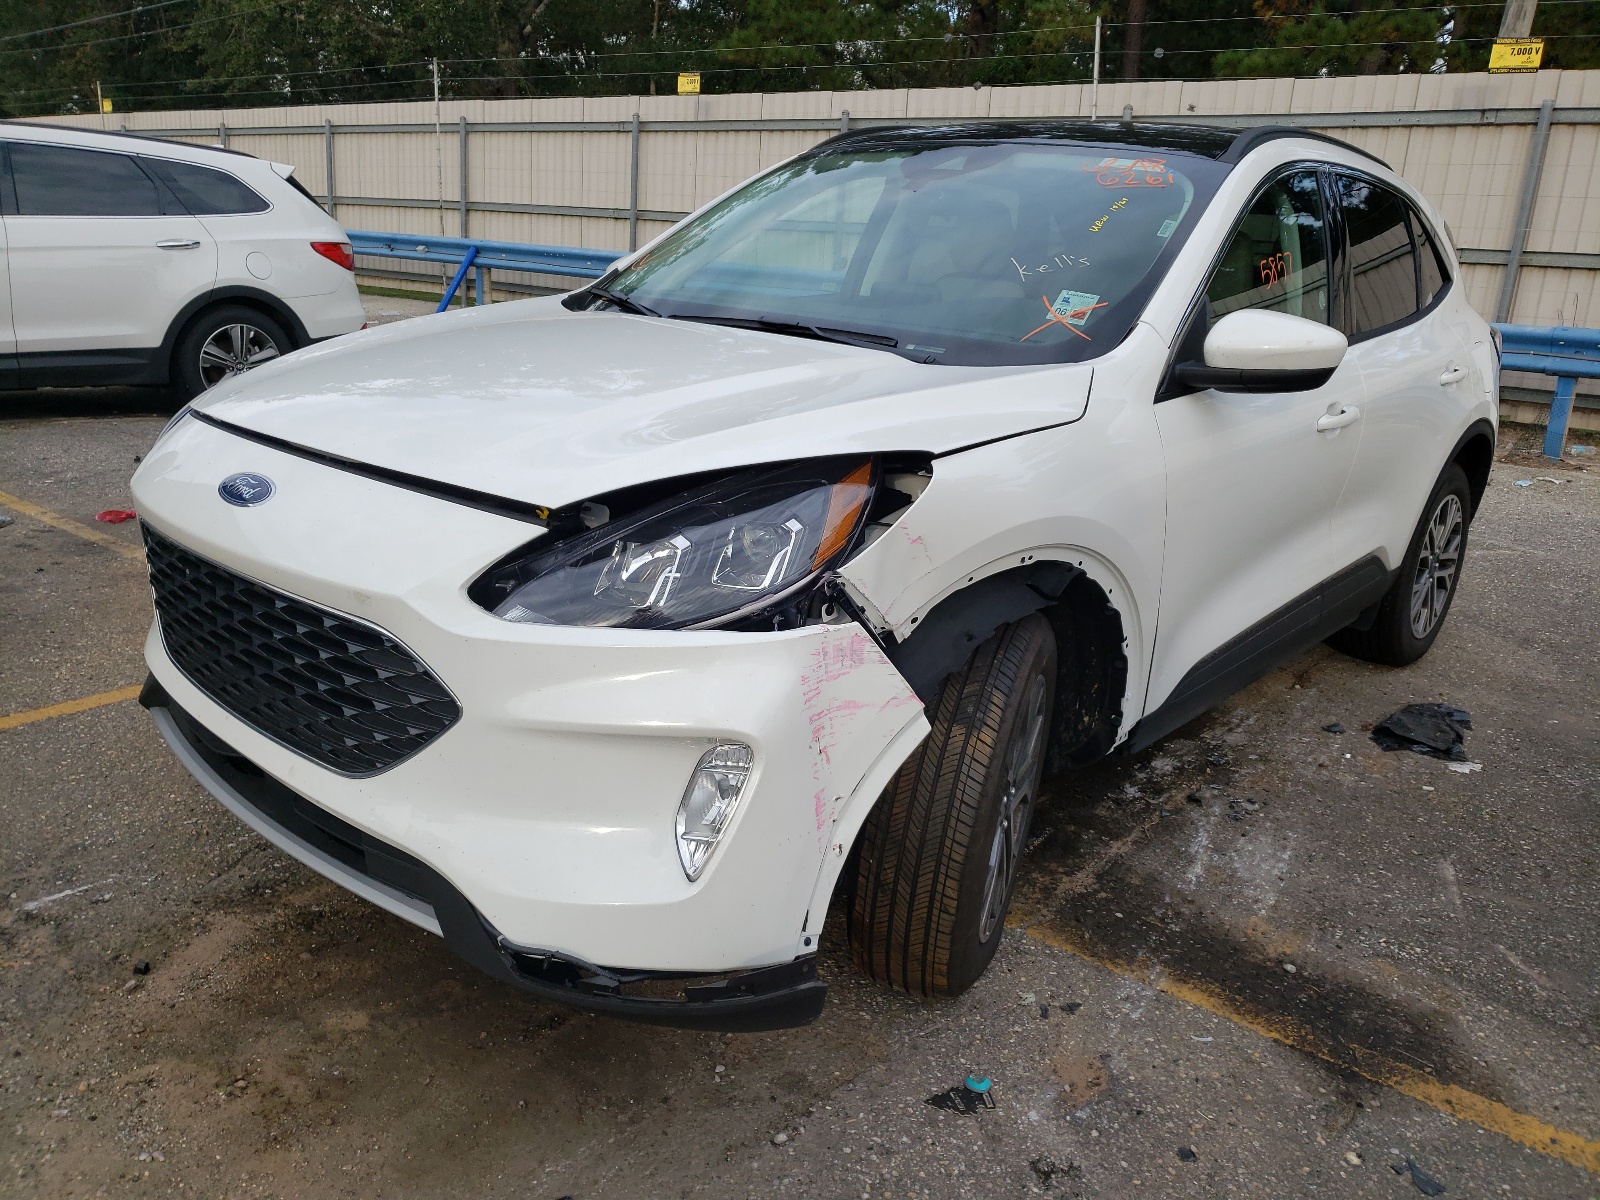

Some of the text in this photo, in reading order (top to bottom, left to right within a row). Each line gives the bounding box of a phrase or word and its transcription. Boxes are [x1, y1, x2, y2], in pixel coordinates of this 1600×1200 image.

[1510, 46, 1541, 56] 7,000 V
[1260, 251, 1294, 290] 5857
[1055, 307, 1068, 316] 06
[227, 476, 262, 499] Ford
